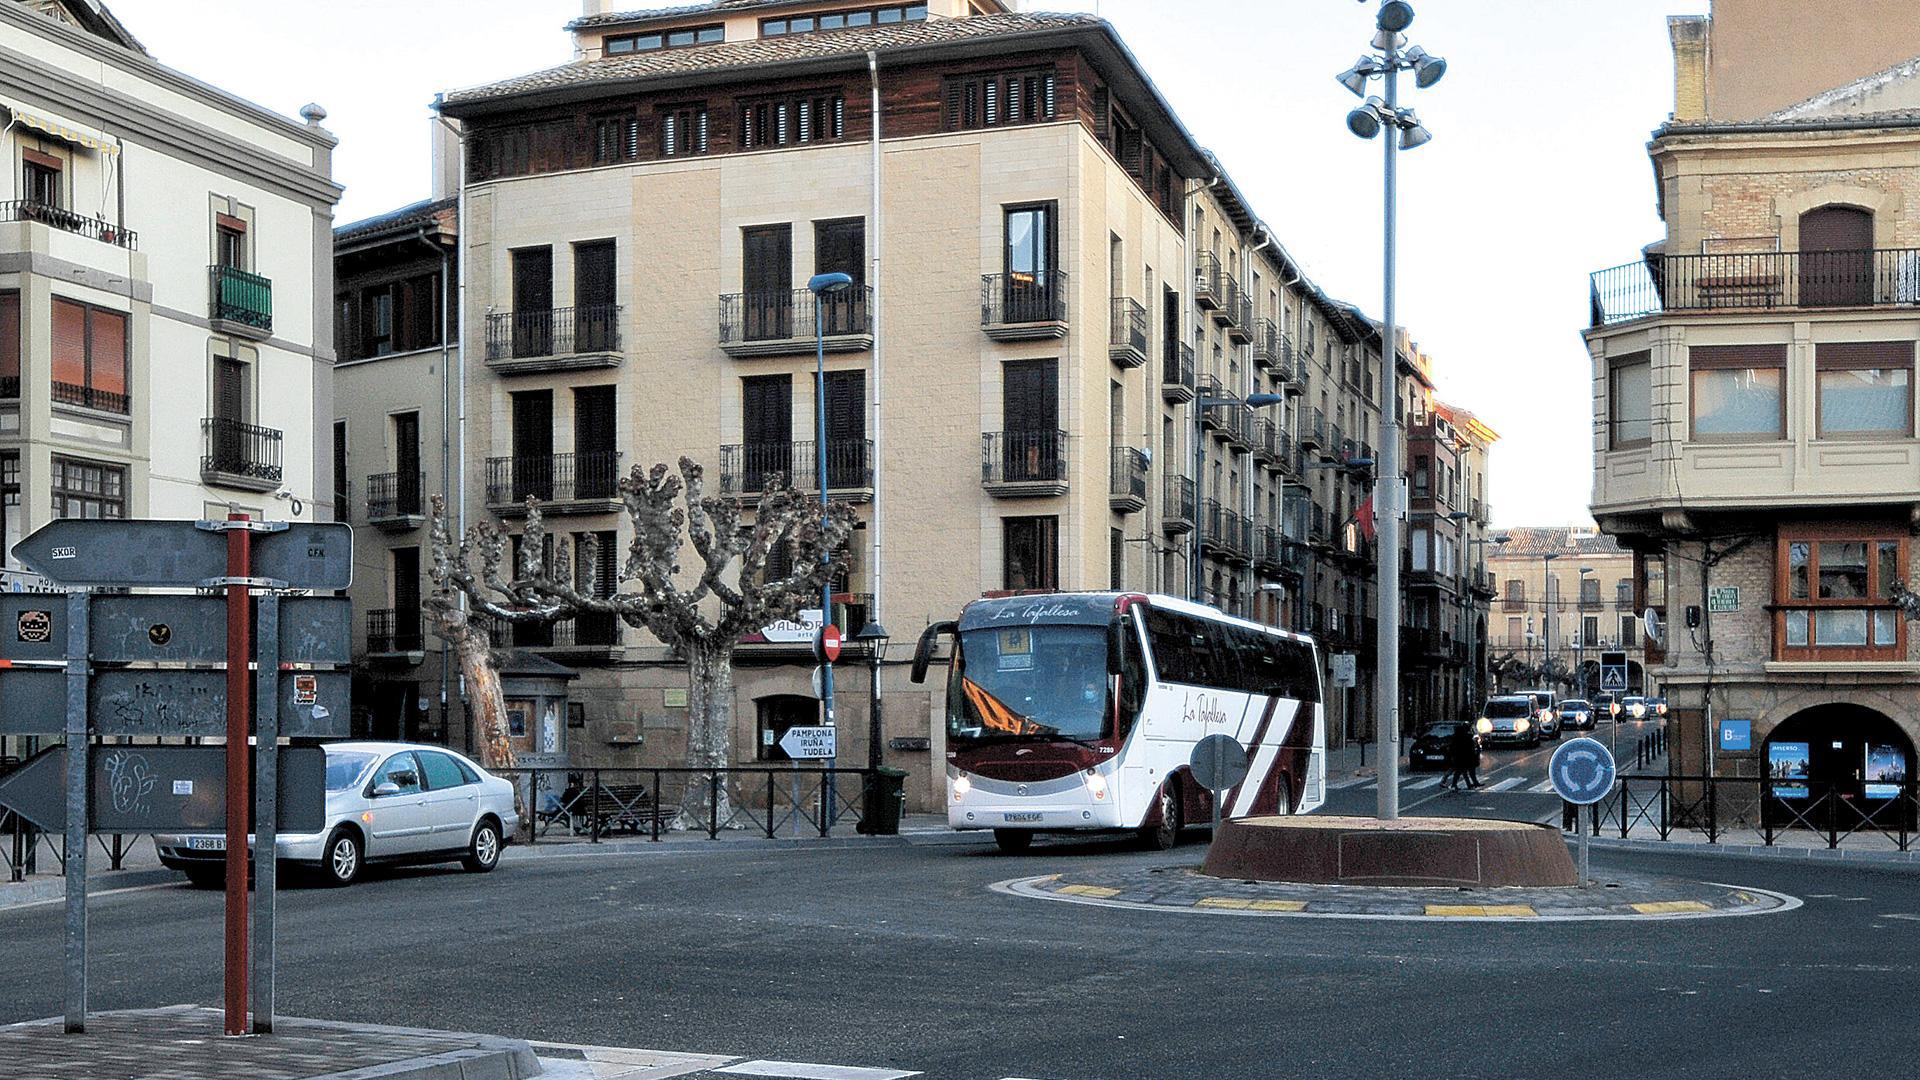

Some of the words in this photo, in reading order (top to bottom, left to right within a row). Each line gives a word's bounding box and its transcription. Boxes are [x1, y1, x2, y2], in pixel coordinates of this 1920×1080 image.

[52, 548, 76, 557] SKOR
[990, 607, 1015, 620] La
[1022, 604, 1080, 624] Tafallesa
[1182, 691, 1195, 723] La
[791, 729, 833, 737] PAMPLONA
[800, 737, 824, 747] IRUÑA
[802, 748, 833, 756] TUDELA
